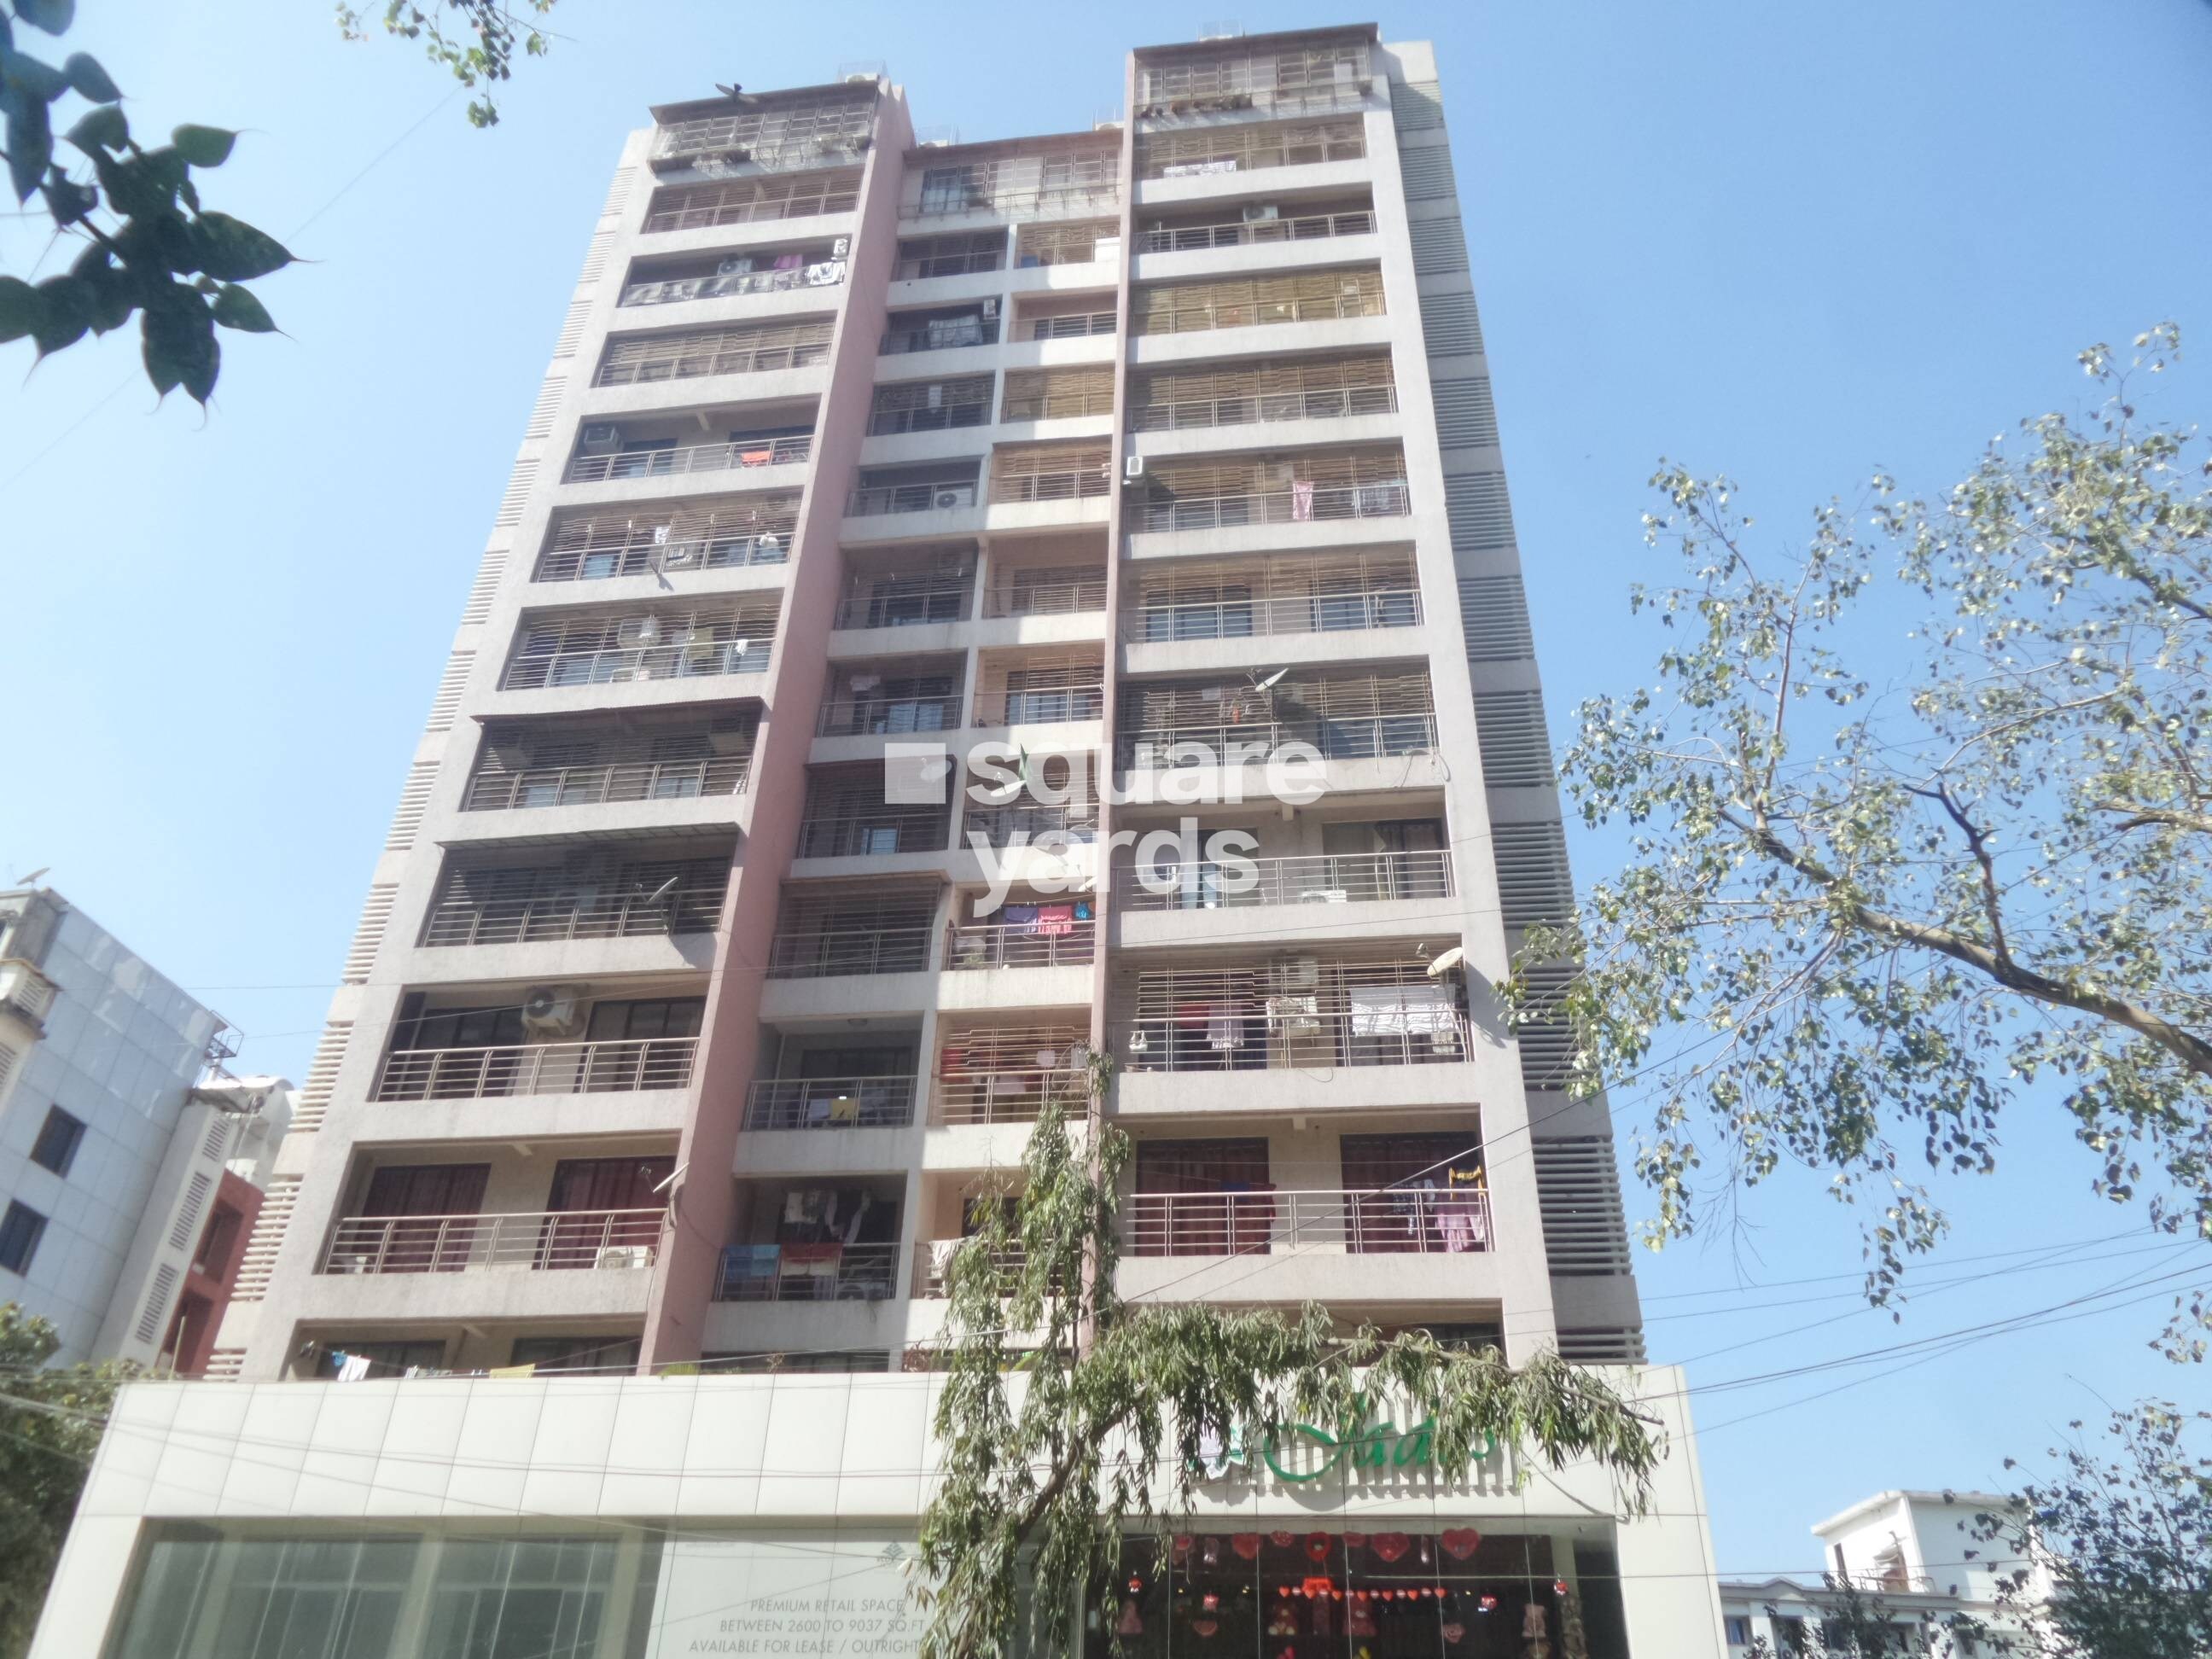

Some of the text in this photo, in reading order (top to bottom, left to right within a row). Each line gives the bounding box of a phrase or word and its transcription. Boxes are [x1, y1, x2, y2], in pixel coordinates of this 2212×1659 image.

[750, 1598, 810, 1612] PREMIUM
[816, 1598, 856, 1612] RETAIL
[719, 1619, 783, 1633] BETWEEN
[788, 1619, 821, 1633] 2600
[825, 1619, 844, 1633] TO
[848, 1619, 882, 1633] 9037
[689, 1639, 759, 1653] AVAILABLE
[764, 1639, 792, 1653] FOR
[795, 1639, 834, 1653] LEASE
[852, 1639, 921, 1653] OUTRIGHT
